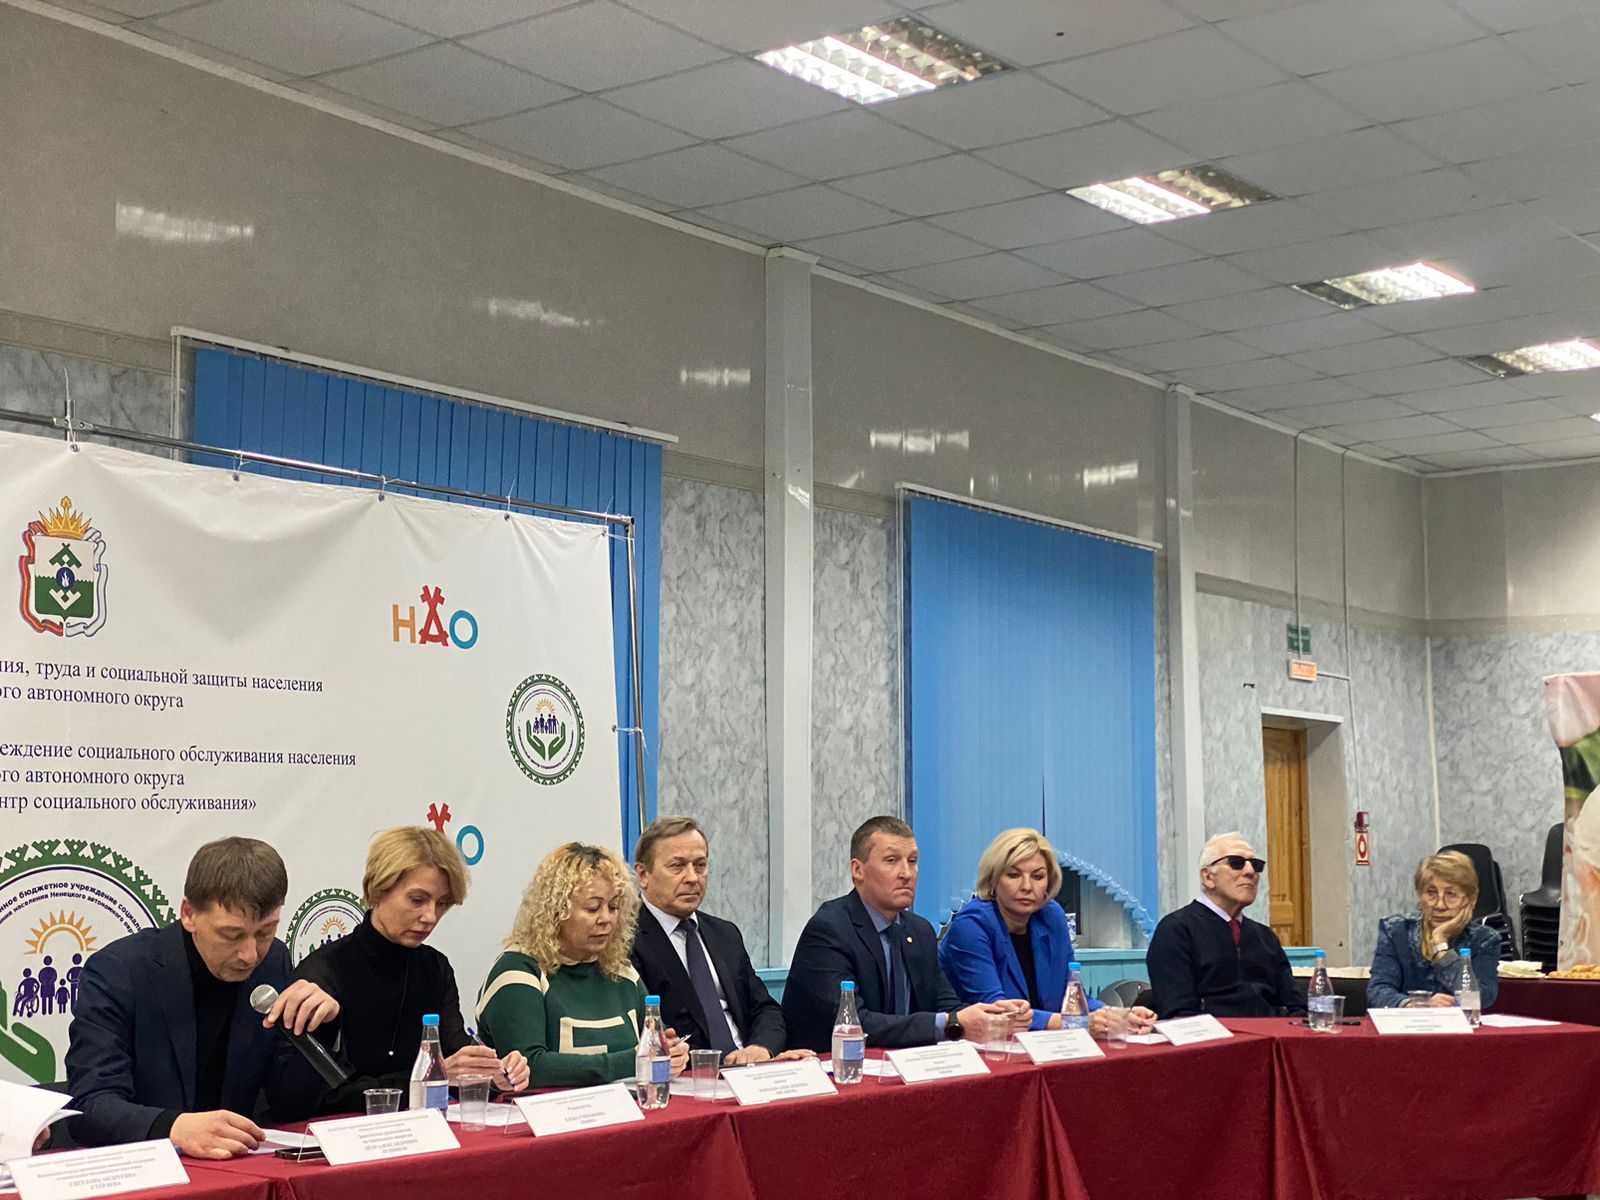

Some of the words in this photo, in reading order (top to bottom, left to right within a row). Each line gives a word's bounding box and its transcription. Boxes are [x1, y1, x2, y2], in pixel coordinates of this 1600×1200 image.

[35, 662, 80, 680] труда
[85, 666, 96, 678] и
[100, 666, 188, 684] социальной
[192, 673, 247, 688] защиты
[252, 676, 323, 692] населения
[27, 687, 130, 705] автономного
[134, 693, 184, 711] округа
[78, 746, 175, 760] социального
[180, 745, 284, 766] обслуживания
[288, 753, 356, 765] населения
[0, 770, 20, 783] го
[25, 770, 130, 785] автономного
[134, 772, 184, 790] округа
[33, 796, 137, 810] социального
[141, 793, 257, 814] обслуживания»
[19, 881, 69, 899] бюджетное
[70, 882, 118, 906] учреждение
[13, 893, 49, 913] населения
[50, 891, 87, 900] Ненецкого
[87, 895, 125, 922] автономного
